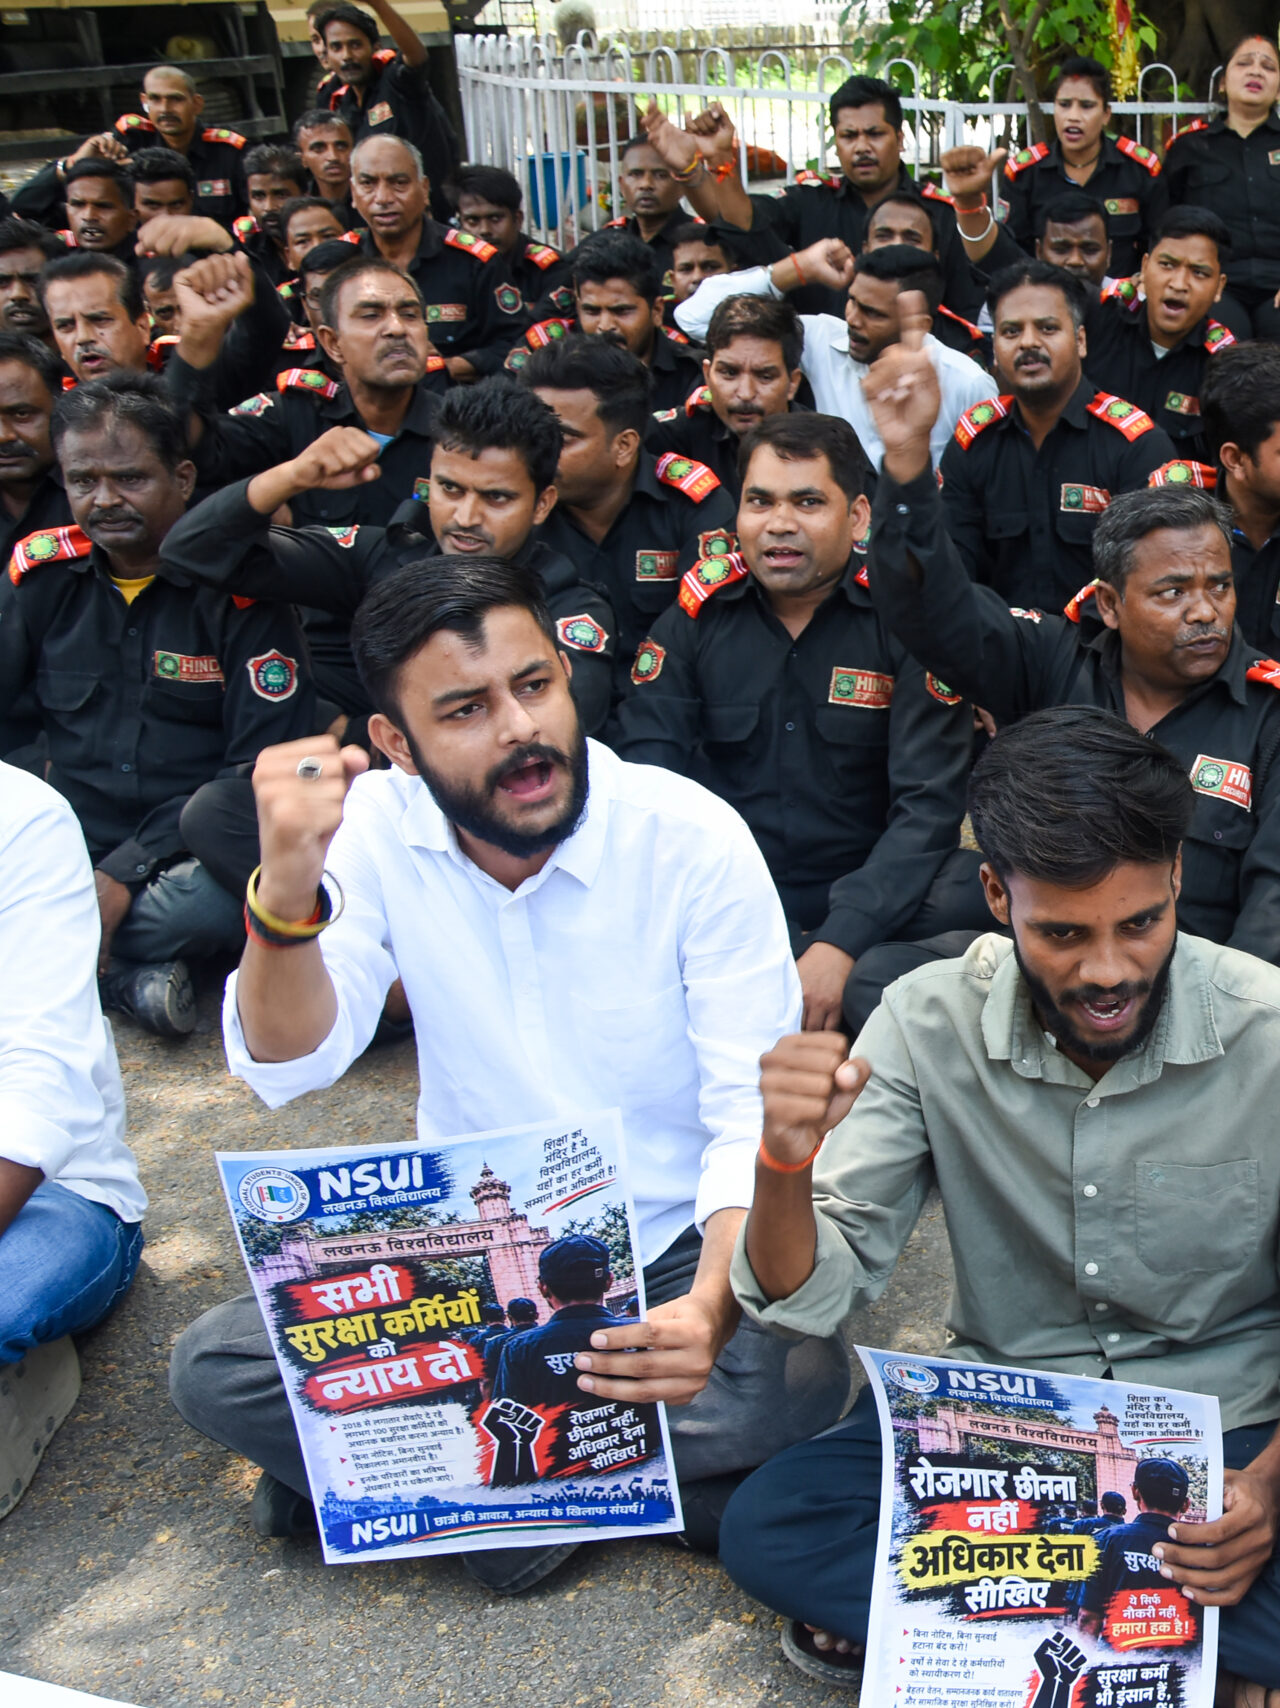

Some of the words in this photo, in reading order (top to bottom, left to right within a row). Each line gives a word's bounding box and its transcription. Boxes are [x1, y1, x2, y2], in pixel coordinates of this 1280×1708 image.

[692, 475, 714, 495] H.S.F.
[856, 675, 893, 694] HIND
[544, 1134, 568, 1152] शिक्षा
[571, 1128, 583, 1139] का
[545, 1147, 567, 1163] मंदिर
[571, 1142, 577, 1153] है
[580, 1137, 588, 1147] ये
[318, 1156, 424, 1201] NSUI
[555, 1173, 568, 1184] का
[570, 1167, 582, 1180] हर
[584, 1155, 603, 1172] कर्मी
[242, 1188, 267, 1217] NATIONAL
[284, 1173, 304, 1191] UNION
[321, 1200, 367, 1214] लखनऊ
[370, 1187, 441, 1209] विश्वविद्यालय
[523, 1192, 553, 1209] सम्मान
[555, 1186, 567, 1197] का
[570, 1168, 605, 1191] अधिकारी
[322, 1242, 380, 1257] लखनऊ
[387, 1230, 494, 1251] विश्वविद्यालय
[311, 1264, 402, 1313] सभी
[285, 1312, 378, 1362] सुरक्षा
[381, 1288, 482, 1336] कर्मियों
[367, 1337, 397, 1359] को
[315, 1358, 423, 1400] न्याय
[423, 1341, 472, 1382] दो
[948, 1370, 1037, 1398] NSUI
[948, 1388, 988, 1401] लखनऊ
[989, 1392, 1054, 1408] विश्वविद्यालय
[1126, 1402, 1151, 1411] मंदिर
[1154, 1402, 1161, 1412] है
[1127, 1394, 1150, 1402] शिक्षा
[373, 1427, 387, 1436] 100
[389, 1424, 409, 1436] सुरक्षा
[566, 1421, 607, 1442] छीनना
[969, 1419, 1011, 1434] लखनऊ
[1015, 1425, 1098, 1448] विश्वविद्यालय
[1157, 1421, 1169, 1429] हर
[1160, 1429, 1192, 1437] अधिकारी
[568, 1433, 620, 1460] अधिकार
[621, 1423, 646, 1441] देना
[908, 1456, 1009, 1500] रोजगार
[1013, 1466, 1077, 1501] छीनना
[433, 1510, 459, 1527] छात्रों
[460, 1510, 476, 1523] की
[515, 1508, 549, 1519] अन्याय
[552, 1505, 563, 1517] के
[608, 1502, 645, 1515] संघर्ष!
[966, 1500, 1020, 1533] नहीं
[352, 1513, 417, 1546] NSUI
[909, 1534, 1031, 1579] अधिकार
[1035, 1536, 1086, 1575] देना
[964, 1575, 1051, 1613] सीखिए
[1129, 1594, 1138, 1605] ये
[1139, 1593, 1162, 1606] सिर्फ
[1122, 1605, 1156, 1620] नौकरी
[913, 1627, 929, 1638] बिना
[957, 1630, 973, 1640] बिना
[1111, 1622, 1147, 1637] हमारा
[1150, 1621, 1171, 1635] हक
[1174, 1617, 1189, 1635] है!
[1096, 1668, 1138, 1688] सुरक्षा
[1140, 1663, 1170, 1680] कर्मी
[1095, 1689, 1114, 1706] भी
[1116, 1686, 1155, 1706] इंसान
